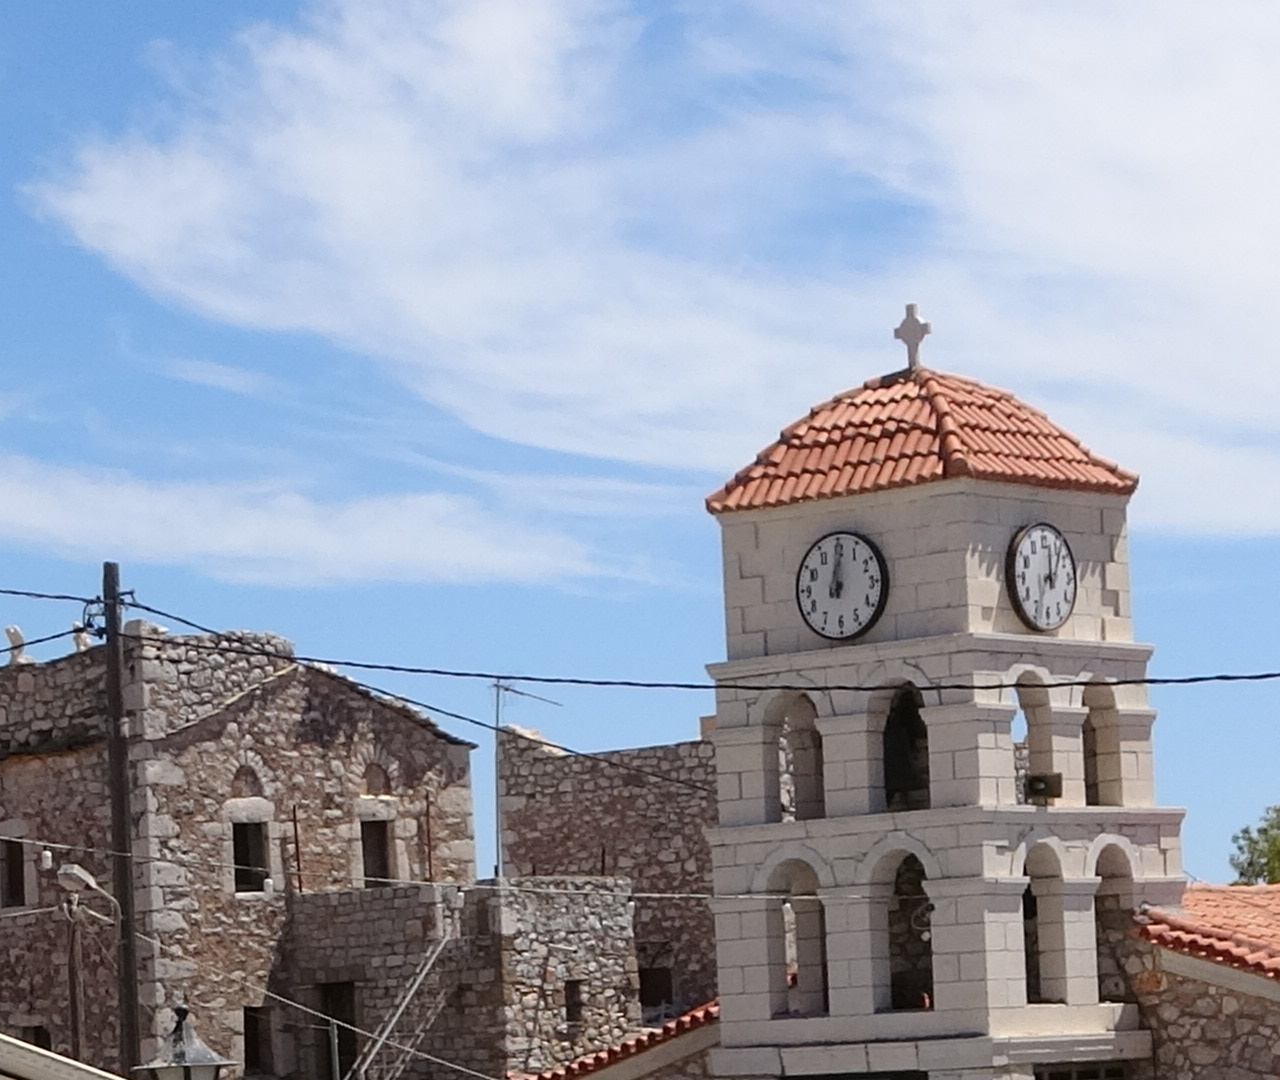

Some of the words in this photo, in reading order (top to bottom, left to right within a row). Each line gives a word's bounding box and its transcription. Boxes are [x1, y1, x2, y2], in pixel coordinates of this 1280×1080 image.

[852, 547, 857, 561] 1
[1030, 540, 1037, 554] 11
[820, 551, 828, 565] 11
[862, 558, 869, 573] 2
[809, 568, 818, 582] 10
[869, 575, 876, 589] 3
[1021, 571, 1026, 586] 9
[1066, 571, 1072, 586] 3
[805, 585, 812, 598] 9
[810, 599, 817, 613] 8
[864, 593, 871, 607] 4
[853, 608, 860, 622] 5
[1046, 606, 1051, 620] 6
[1056, 602, 1061, 616] 5
[822, 611, 828, 625] 7
[838, 614, 845, 629] 6
